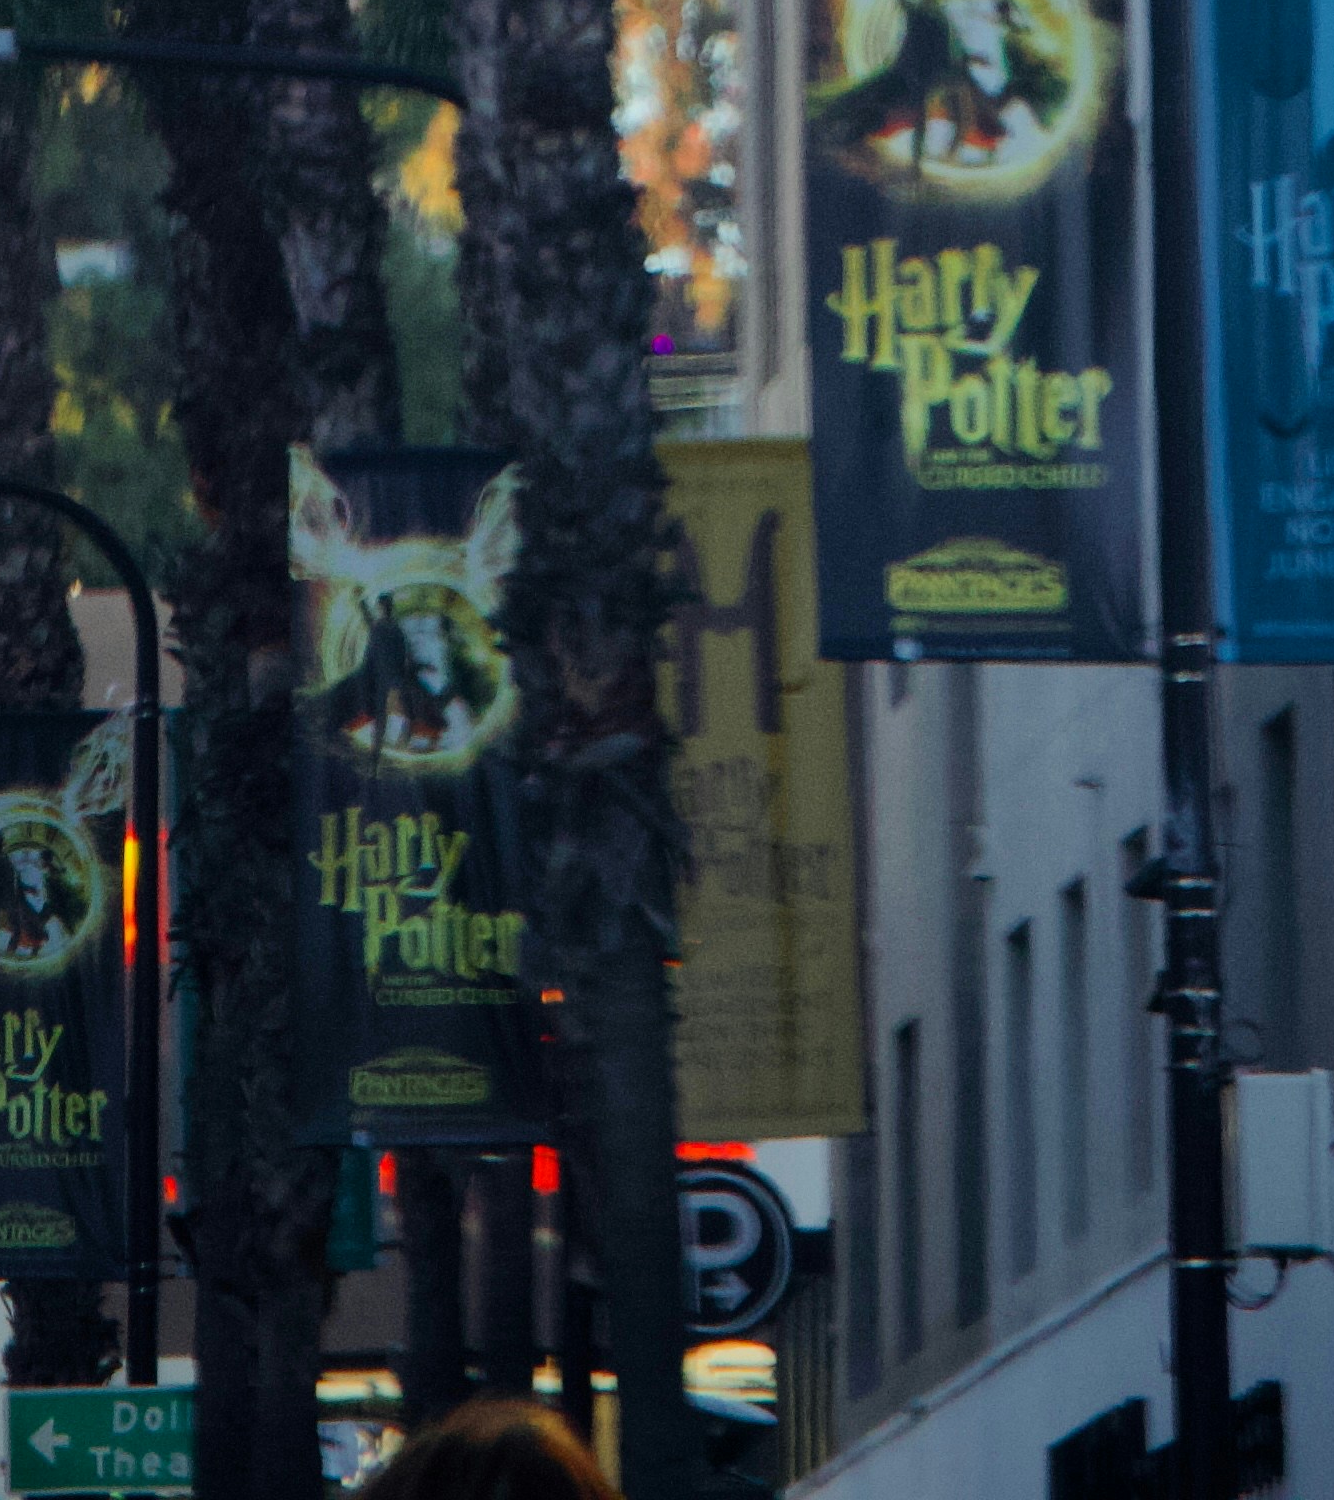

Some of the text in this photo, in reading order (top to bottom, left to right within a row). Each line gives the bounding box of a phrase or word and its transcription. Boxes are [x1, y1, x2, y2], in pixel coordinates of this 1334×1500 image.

[826, 238, 1040, 373] Harry
[897, 341, 1113, 480] Potter
[307, 806, 471, 914] Harry
[360, 884, 528, 990] Potter
